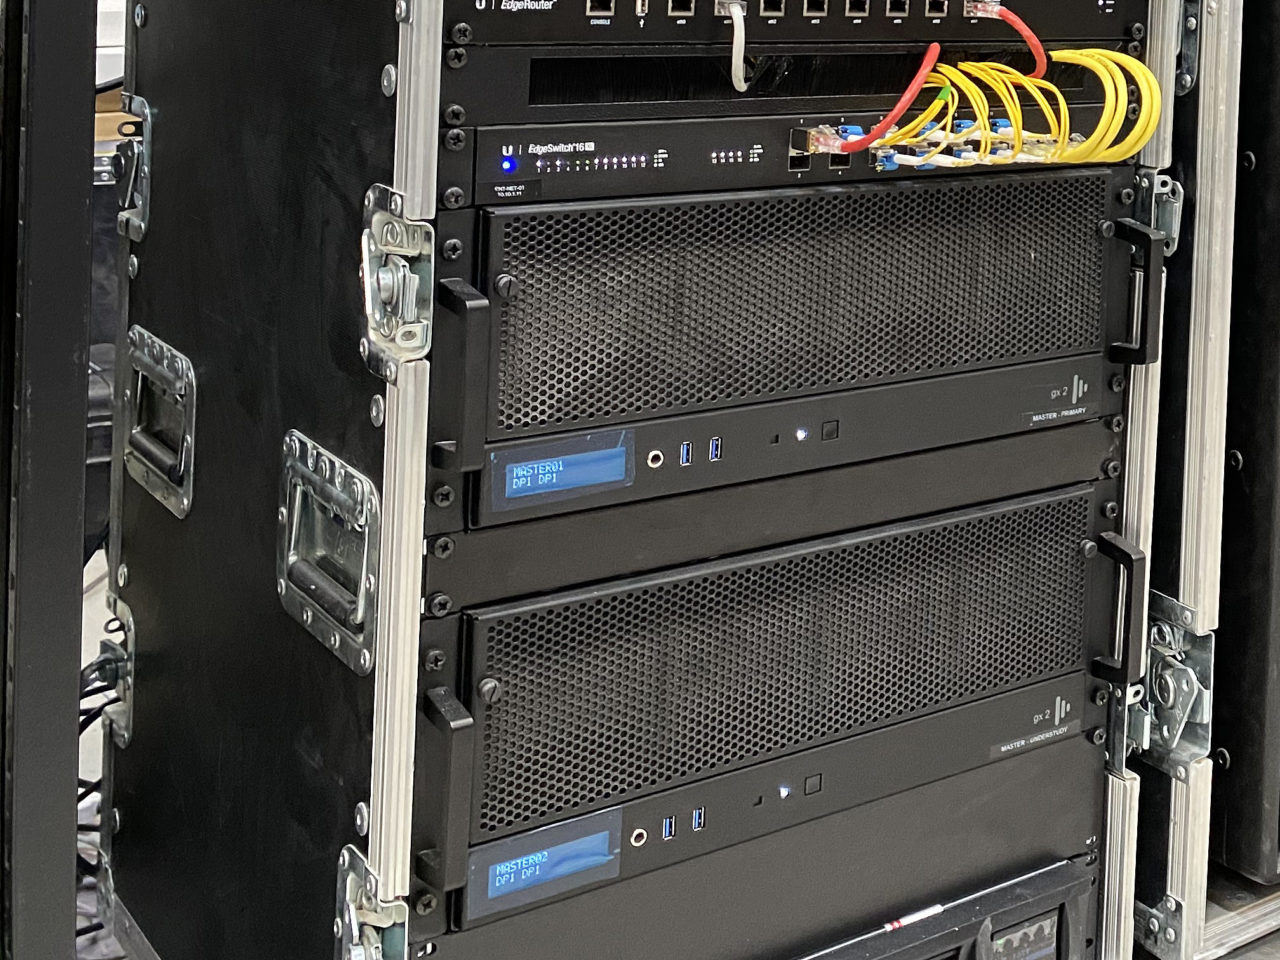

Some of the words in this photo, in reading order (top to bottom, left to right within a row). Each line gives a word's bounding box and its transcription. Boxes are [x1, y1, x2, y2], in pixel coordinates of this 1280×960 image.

[1033, 412, 1057, 421] MASTER
[1061, 407, 1086, 417] PRIMARY
[513, 460, 563, 478] MASTER01
[1044, 709, 1051, 719] 2
[1001, 739, 1026, 752] MASTER
[1030, 726, 1068, 744] UNDERSTUDY
[496, 851, 548, 876] MASTER02
